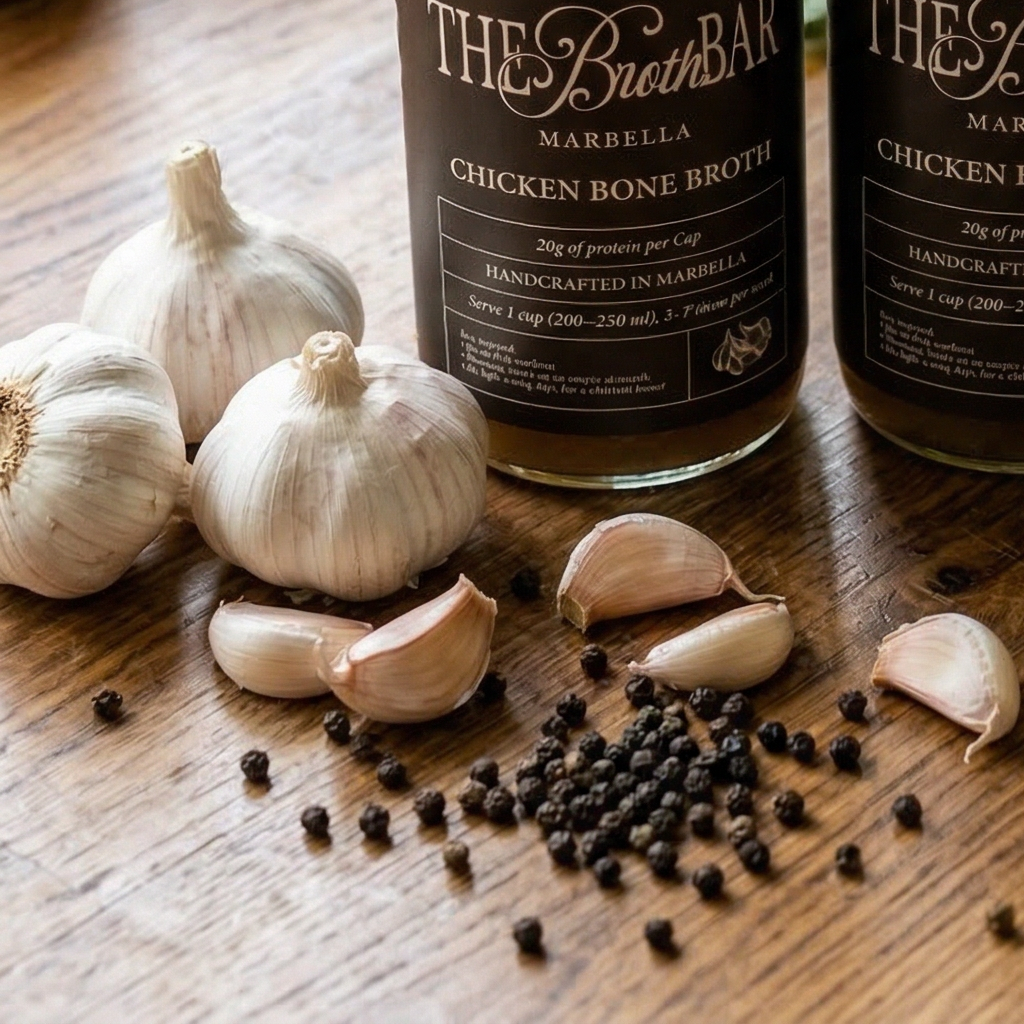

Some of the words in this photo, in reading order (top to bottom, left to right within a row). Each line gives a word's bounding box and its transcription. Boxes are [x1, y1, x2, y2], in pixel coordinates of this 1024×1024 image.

[498, 4, 710, 119] Broth
[538, 123, 692, 149] MARBELLA
[450, 157, 580, 202] CHICKEN
[589, 173, 678, 203] BONE
[684, 139, 772, 192] BROTH
[877, 138, 1006, 185] CHICKEN
[536, 238, 565, 258] 20g
[567, 241, 587, 259] of
[585, 240, 642, 259] protein
[643, 238, 671, 257] per
[673, 231, 702, 248] Cap
[961, 221, 989, 241] 20g
[991, 224, 1011, 242] of
[485, 263, 627, 292] HANDCRAFTED
[631, 275, 651, 290] IN
[656, 251, 747, 287] MARBELLA
[889, 275, 925, 297] Serve
[938, 292, 965, 310] cup
[468, 294, 503, 316] Serve
[518, 310, 544, 327] cup
